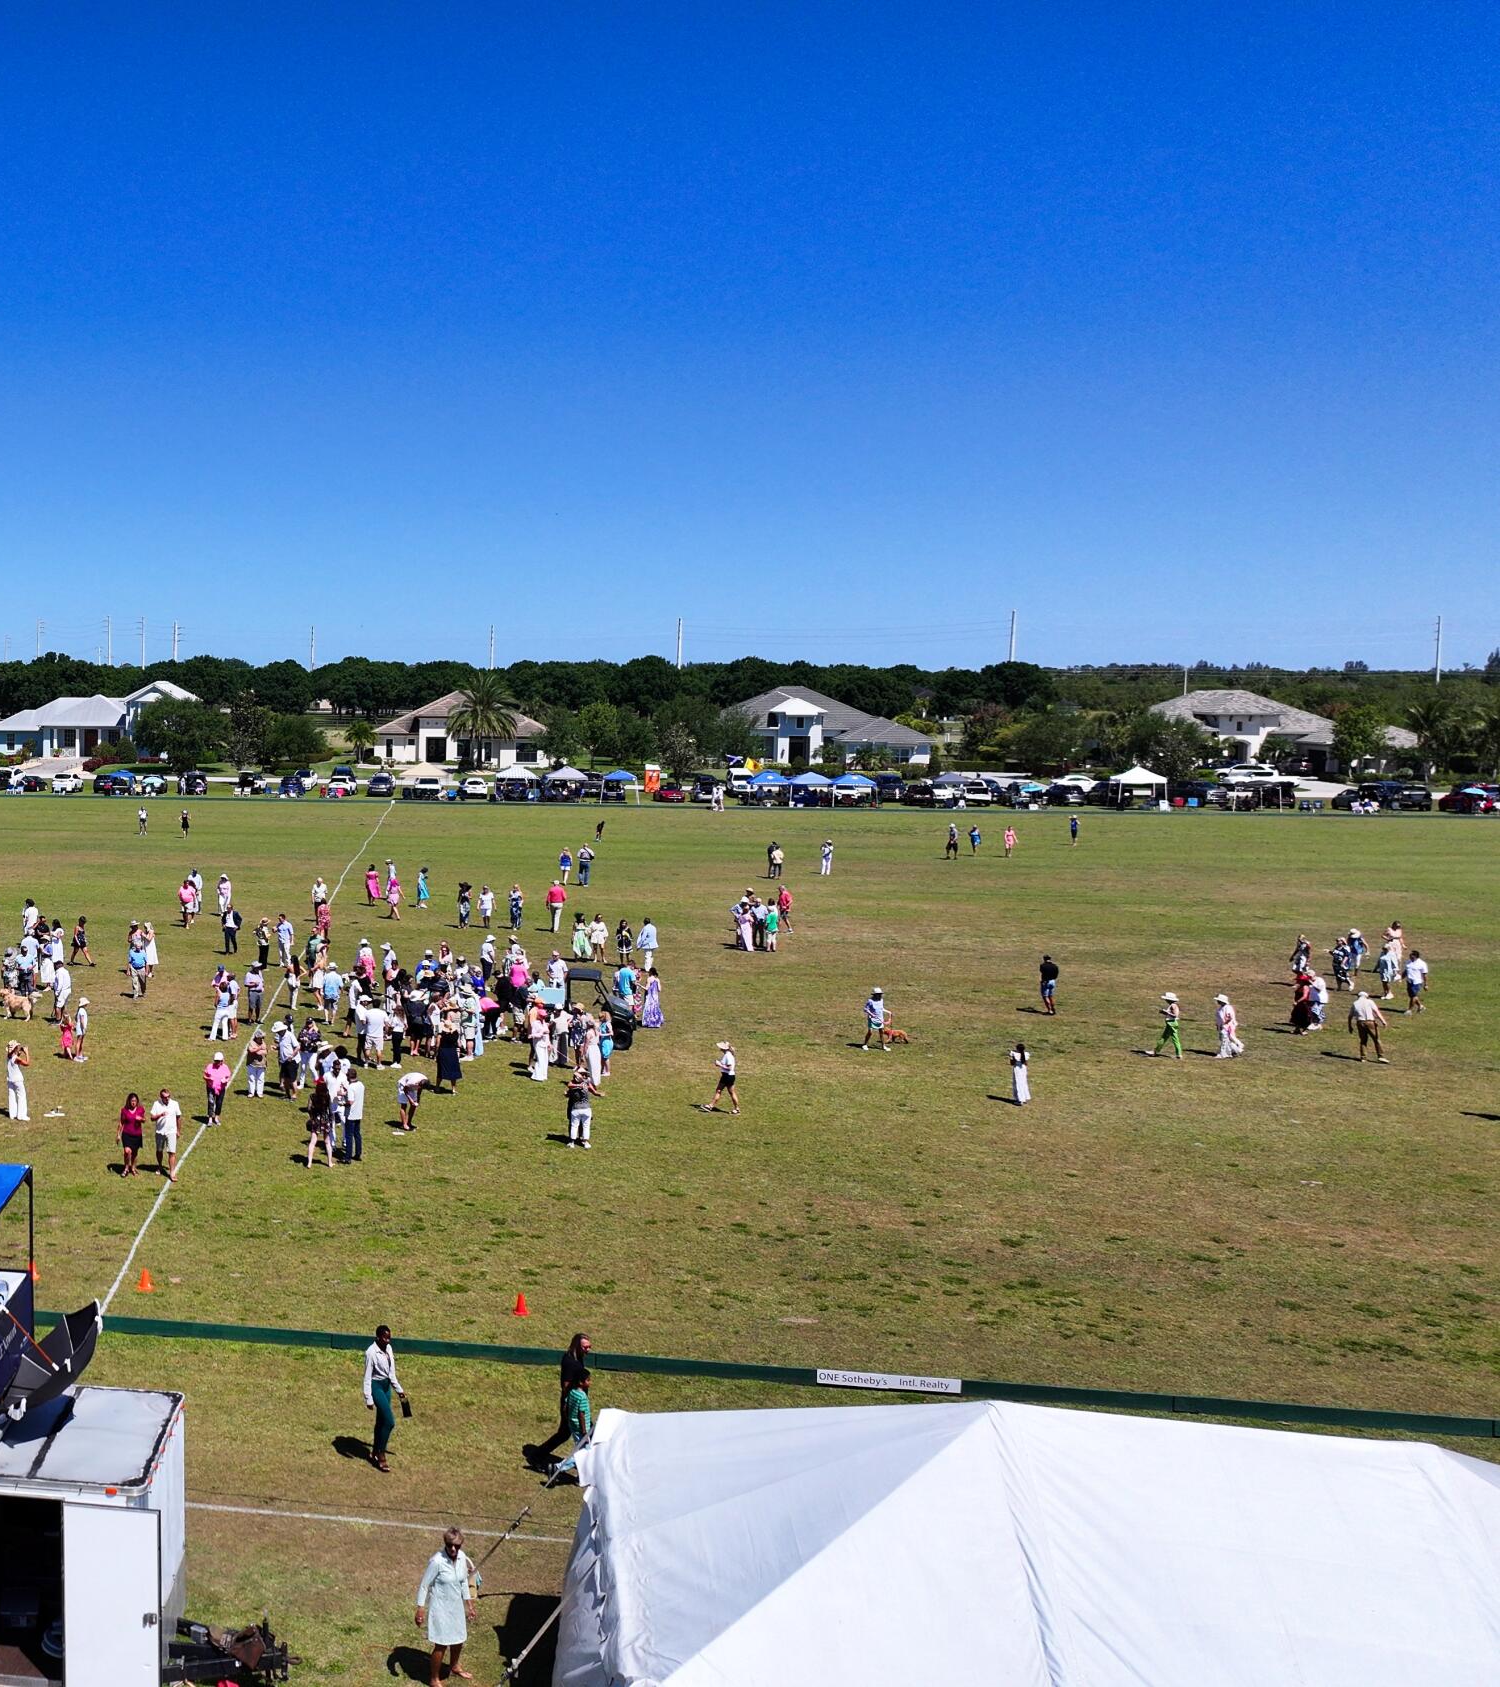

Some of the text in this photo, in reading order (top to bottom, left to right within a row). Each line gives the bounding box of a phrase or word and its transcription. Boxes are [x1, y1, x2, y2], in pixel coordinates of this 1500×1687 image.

[818, 1372, 950, 1391] ONE Sotheby's Intl. Realty
